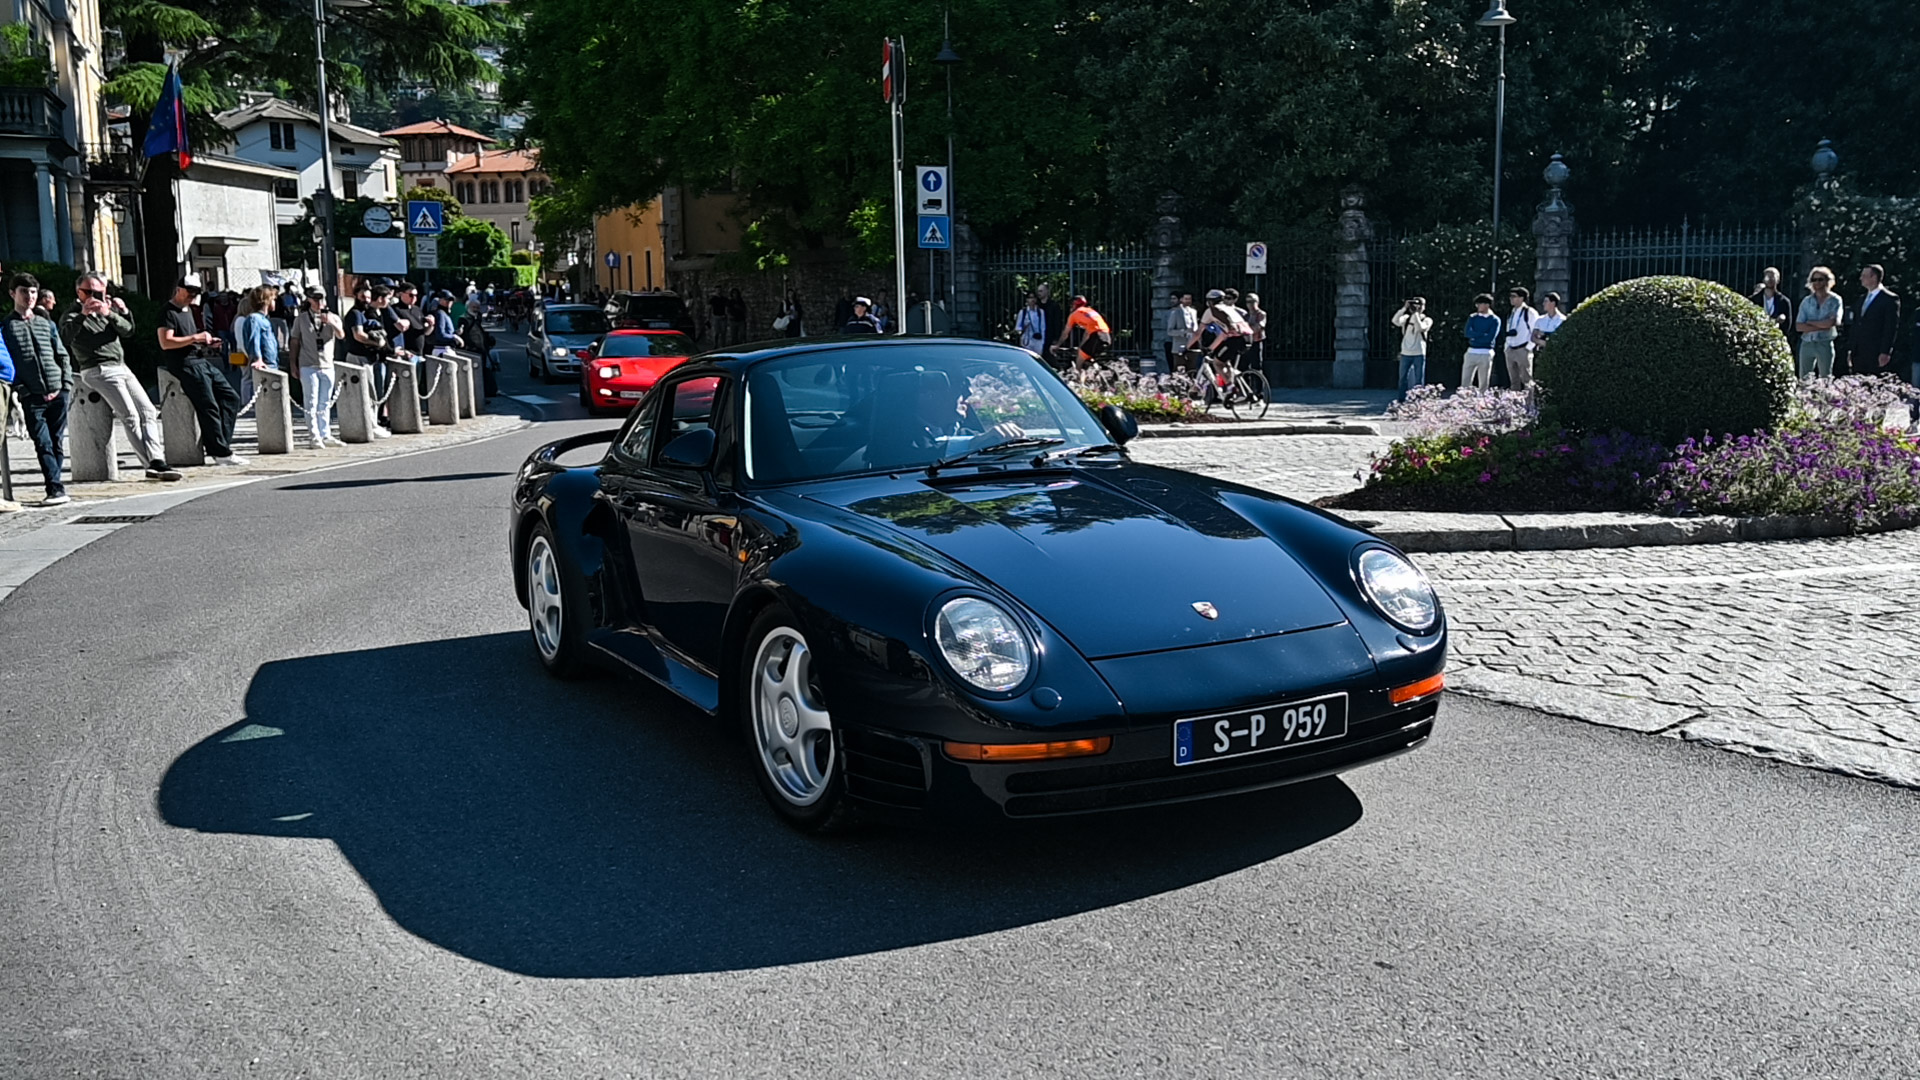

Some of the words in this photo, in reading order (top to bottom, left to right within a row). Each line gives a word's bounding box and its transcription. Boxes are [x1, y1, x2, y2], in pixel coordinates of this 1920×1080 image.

[1213, 714, 1266, 753] S-P
[1282, 703, 1328, 742] 959
[1179, 746, 1188, 757] D
